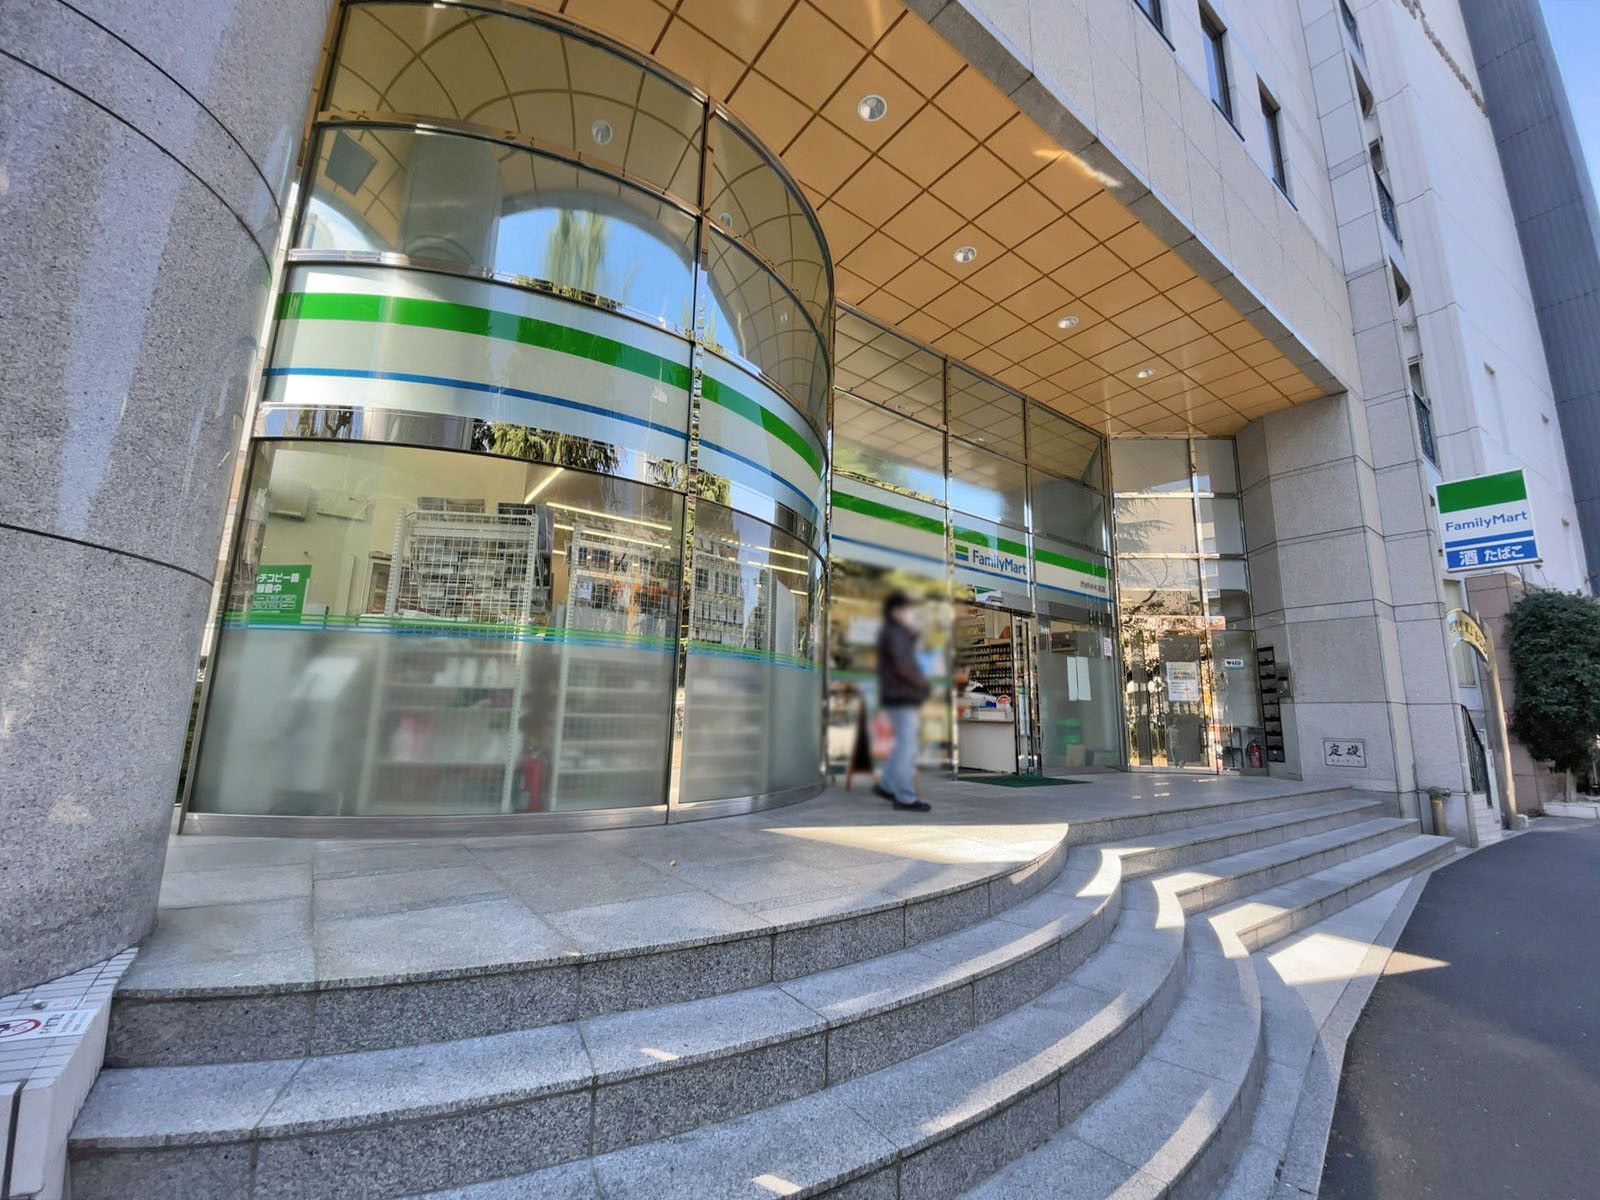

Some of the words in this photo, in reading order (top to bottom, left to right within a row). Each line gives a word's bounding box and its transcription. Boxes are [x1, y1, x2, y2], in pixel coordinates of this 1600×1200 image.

[1445, 511, 1528, 531] FamilyMart
[972, 549, 1027, 576] FamilyMart
[1459, 549, 1478, 565] 酒
[1484, 546, 1524, 561] たばこ
